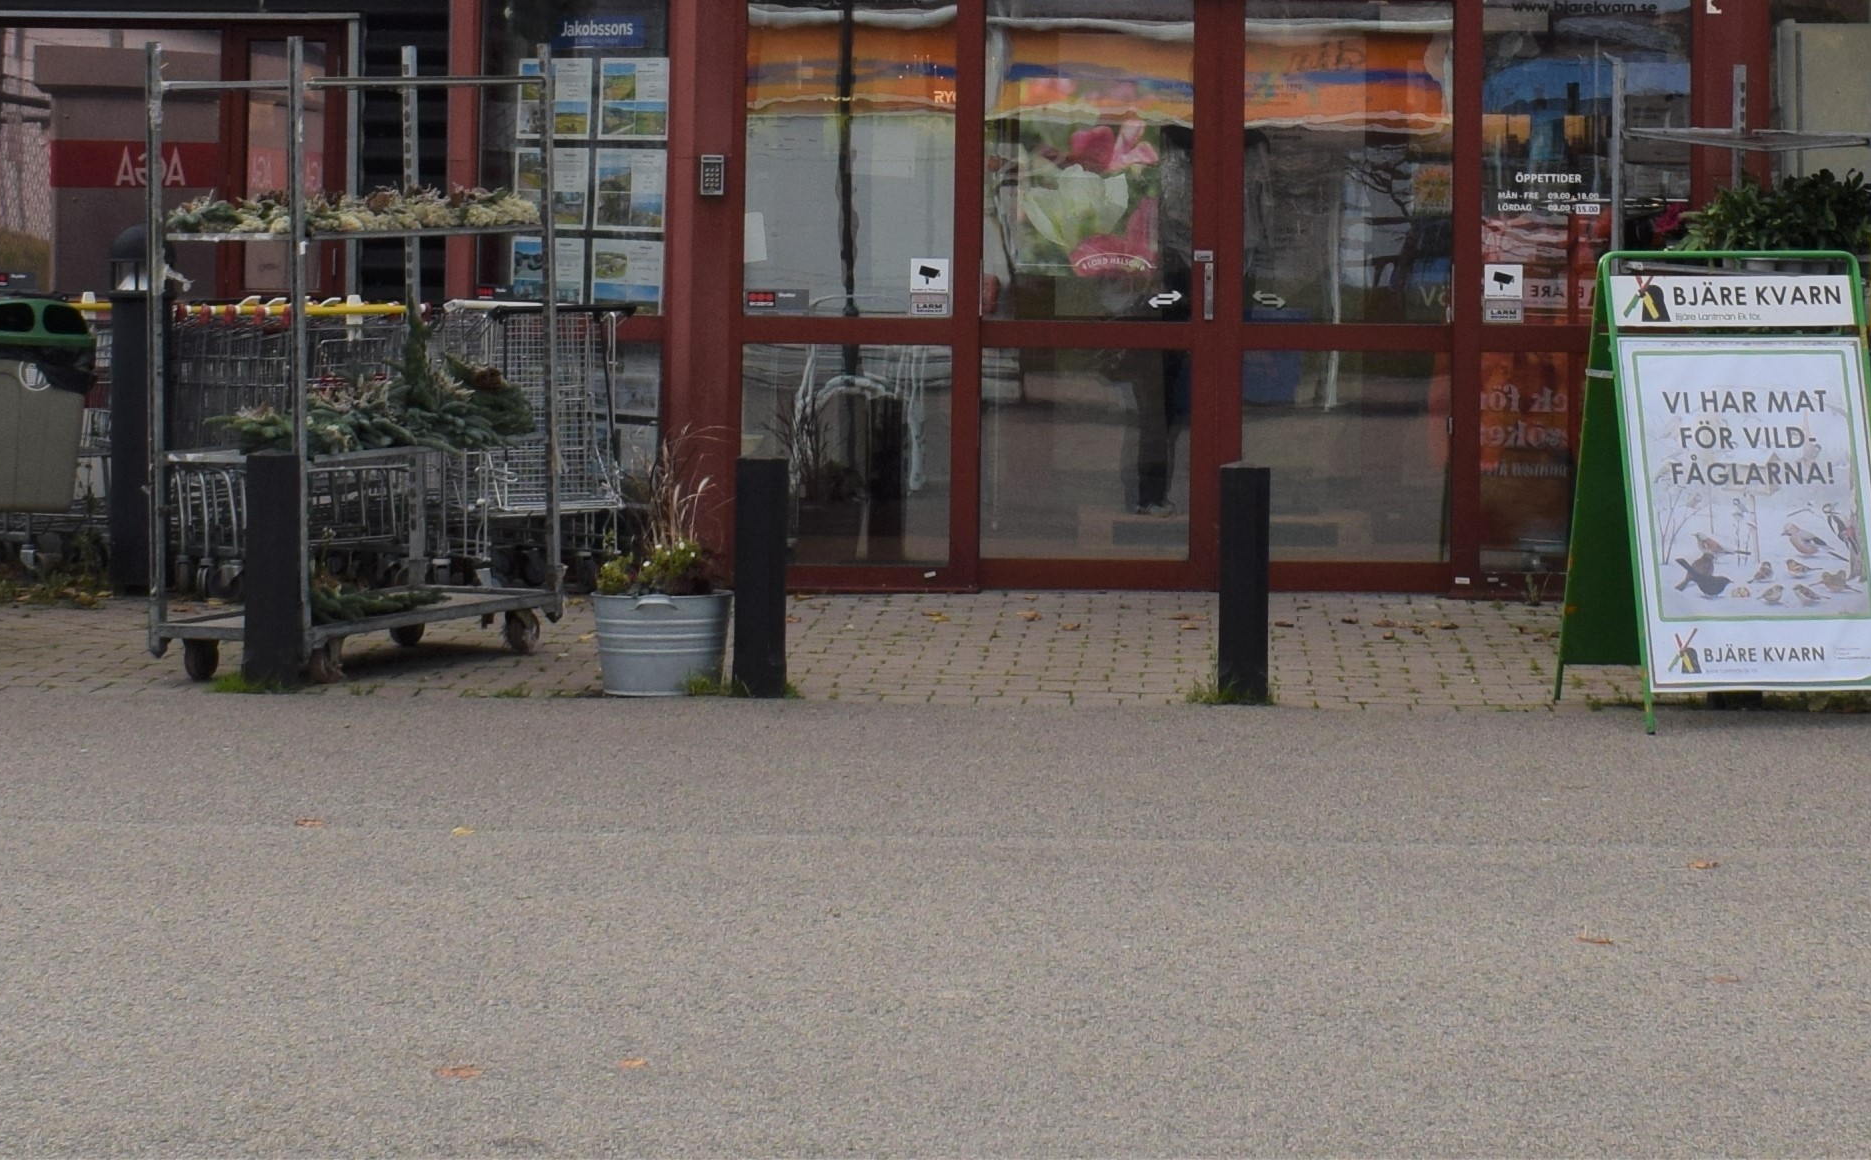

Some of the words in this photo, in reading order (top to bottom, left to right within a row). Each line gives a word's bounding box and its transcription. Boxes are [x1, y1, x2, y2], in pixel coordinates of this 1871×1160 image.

[561, 20, 634, 38] Jakobssons
[1515, 171, 1582, 184] ÖPPETTIDER
[1497, 203, 1532, 212] LÖRDAG
[1673, 282, 1747, 306] BJÄRE
[1756, 286, 1841, 305] KVARN
[1662, 391, 1690, 413] VI
[1701, 391, 1757, 413] HAR
[1768, 390, 1826, 412] MAT
[1680, 420, 1735, 449] FÖR
[1743, 427, 1817, 449] VILD-
[1671, 454, 1835, 485] FÅGLARNA!
[1704, 644, 1757, 662] BJÄRE
[1764, 647, 1824, 661] KVARN
